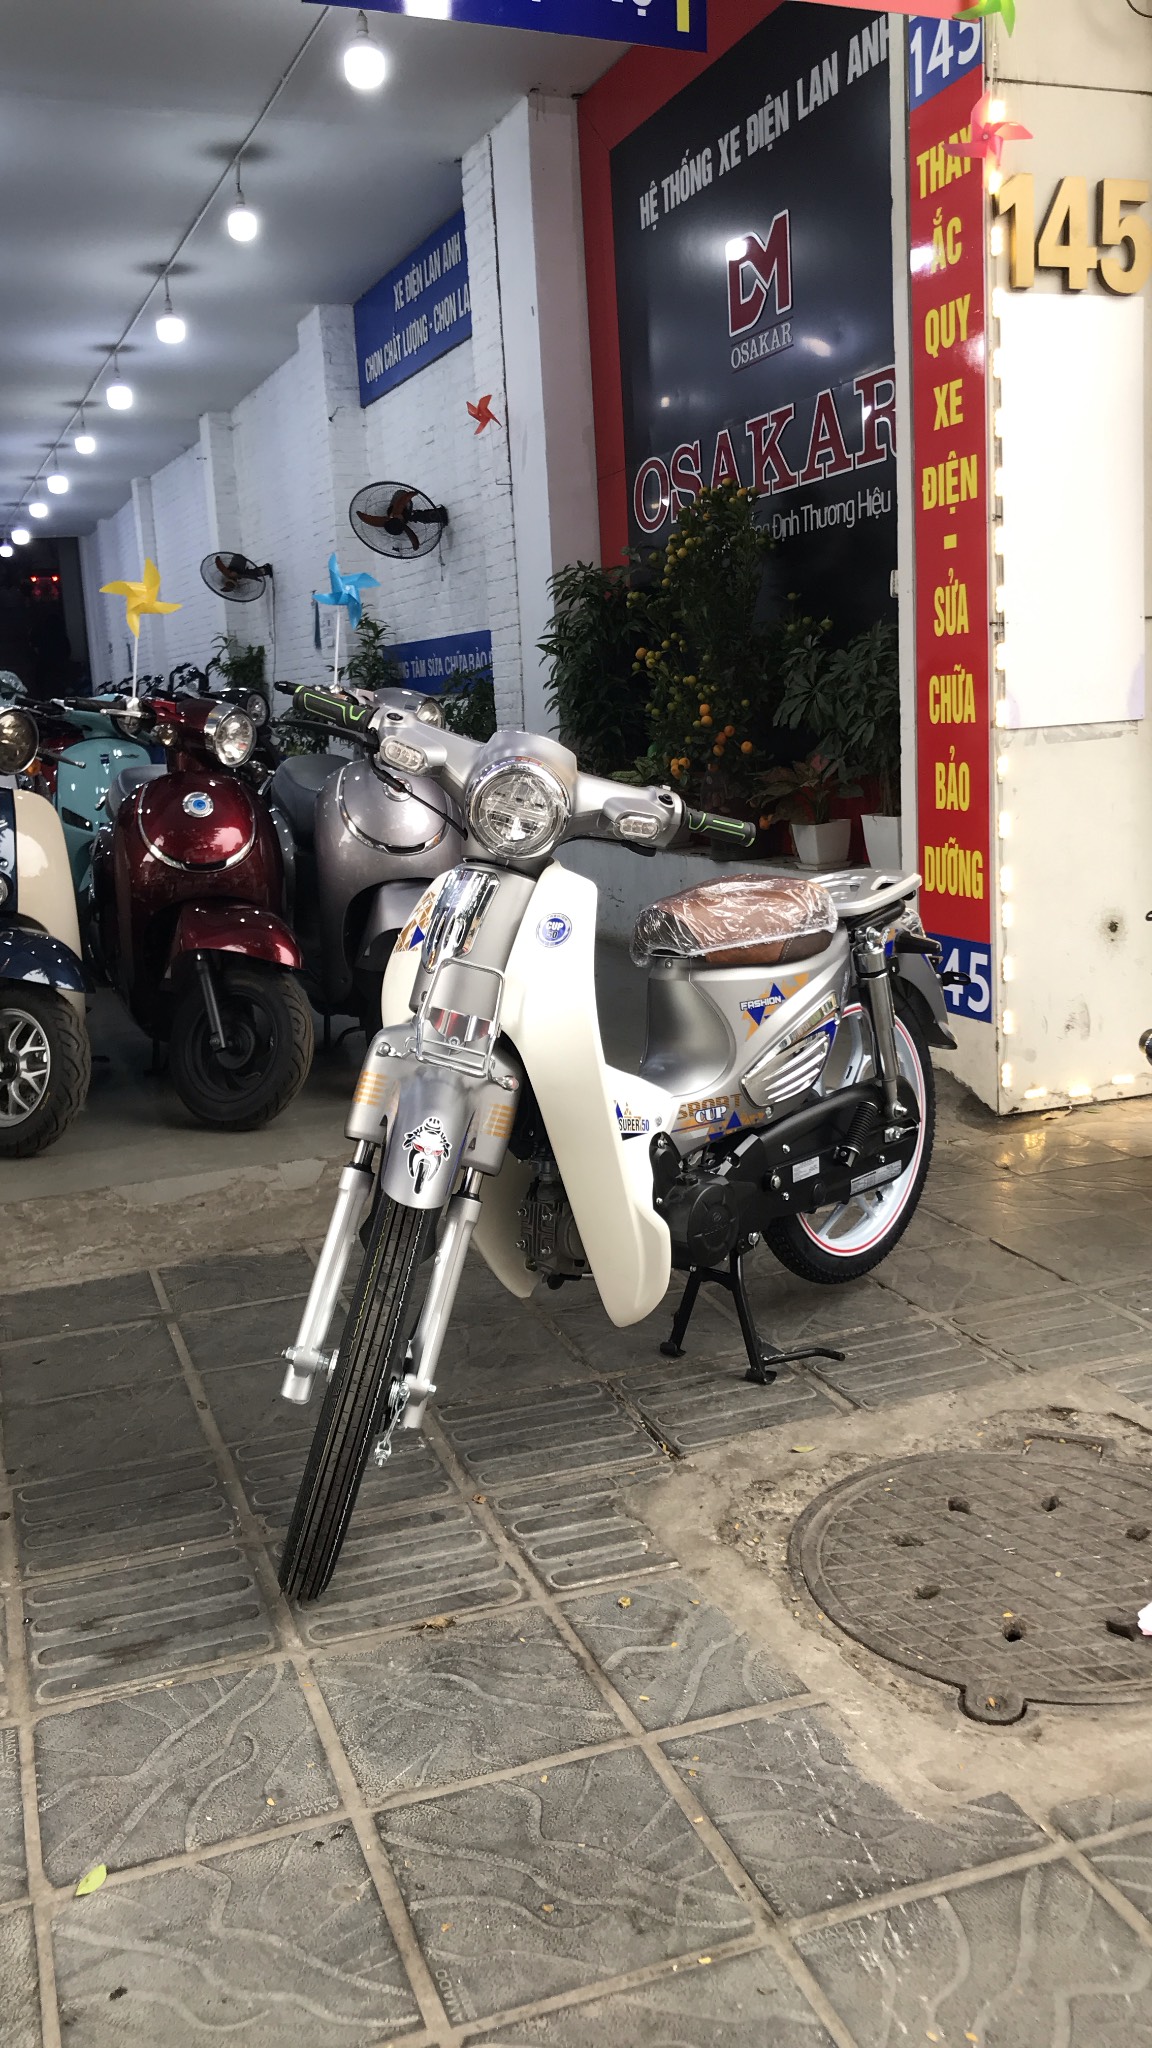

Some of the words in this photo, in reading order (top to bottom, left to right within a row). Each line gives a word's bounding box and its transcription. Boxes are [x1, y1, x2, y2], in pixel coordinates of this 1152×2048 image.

[639, 180, 659, 231] HỆ
[661, 148, 713, 214] THỐNG
[717, 125, 742, 177] XE
[746, 94, 790, 152] ĐIỆN
[796, 51, 839, 122] LAN
[916, 124, 972, 200] THAY
[930, 206, 962, 275] ẮC
[999, 172, 1151, 295] 145
[393, 280, 405, 313] XE
[405, 263, 424, 302] ĐIỆN
[423, 248, 441, 288] LAN
[443, 232, 461, 274] ANH
[365, 348, 384, 383] CHỌN
[384, 326, 402, 371] CHẤT
[402, 314, 429, 356] LƯỢNG
[433, 291, 457, 335] CHỌN
[458, 282, 472, 317] LA
[730, 321, 793, 370] OSAKAR
[925, 293, 971, 358] QUY
[933, 378, 964, 431] XE
[633, 363, 897, 534] OSAKAR
[801, 498, 856, 534] Thương
[857, 486, 891, 519] Hiệu
[921, 450, 978, 514] ĐIỆN
[933, 567, 970, 637] SỬA
[428, 652, 444, 677] SỬA
[928, 664, 976, 725] CHỮA
[935, 745, 971, 812] BẢO
[924, 836, 984, 900] DƯỠNG
[546, 921, 565, 931] CUP
[740, 995, 782, 1012] FASHION
[942, 947, 990, 1013] 45
[618, 1118, 640, 1131] SUPER
[641, 1119, 650, 1131] 50
[677, 1093, 742, 1120] SPORT
[695, 1105, 727, 1123] CUP
[276, 1800, 339, 1824] AMADO
[435, 1969, 463, 2021] AMADO
